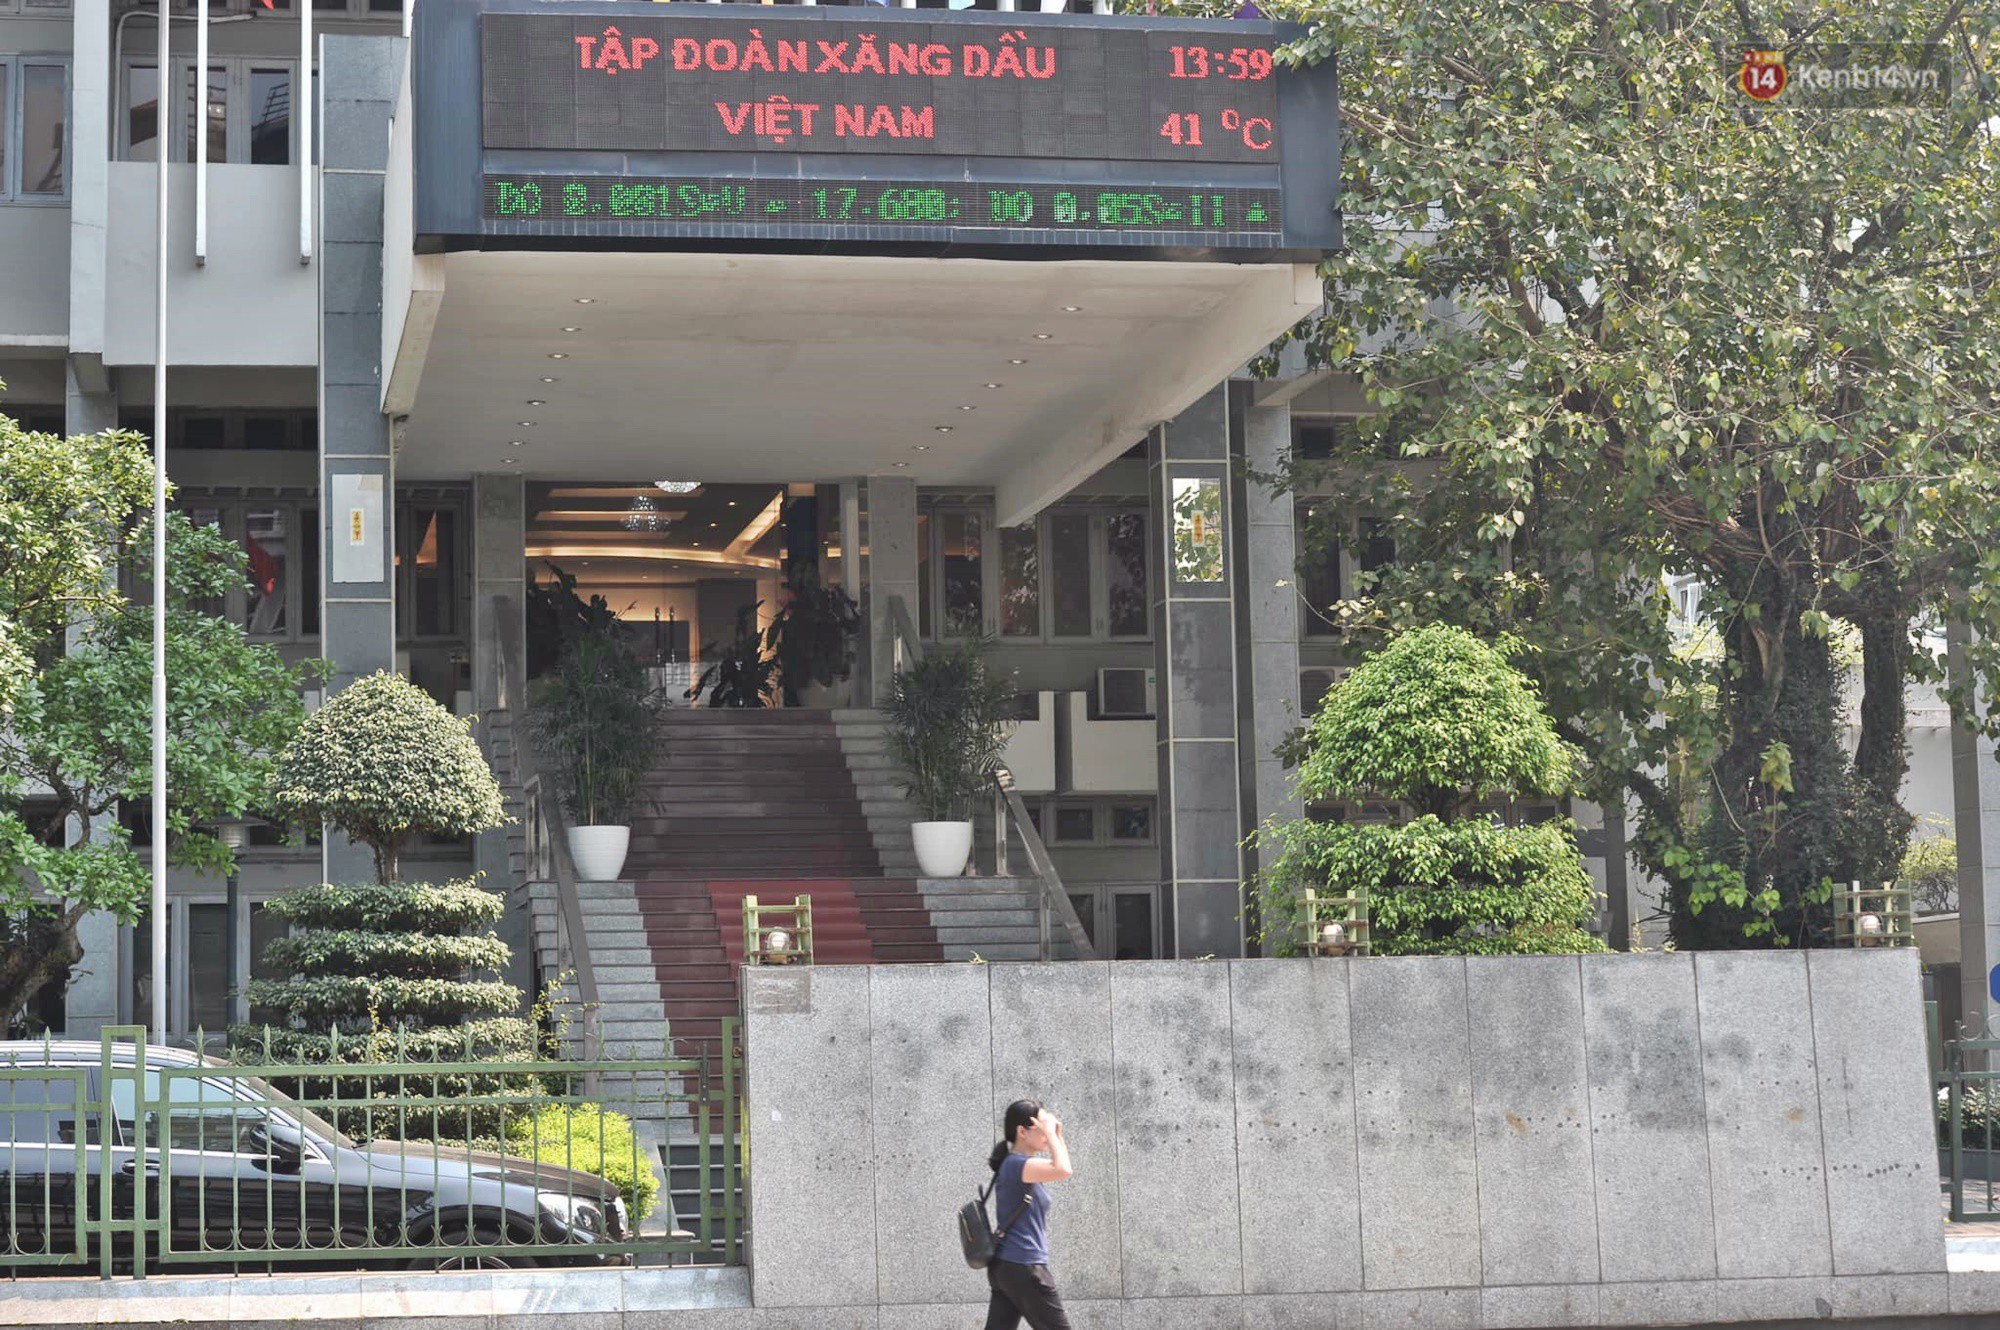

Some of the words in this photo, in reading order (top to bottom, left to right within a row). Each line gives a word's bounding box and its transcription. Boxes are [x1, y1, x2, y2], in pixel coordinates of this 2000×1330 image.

[575, 27, 660, 75] TẬP
[671, 29, 809, 74] ĐOÀN
[815, 34, 953, 77] XĂNG
[963, 31, 1056, 79] DẦU
[1170, 46, 1274, 81] 13:59
[714, 95, 820, 143] VIỆT
[834, 103, 935, 139] NAM
[1161, 112, 1203, 147] 41
